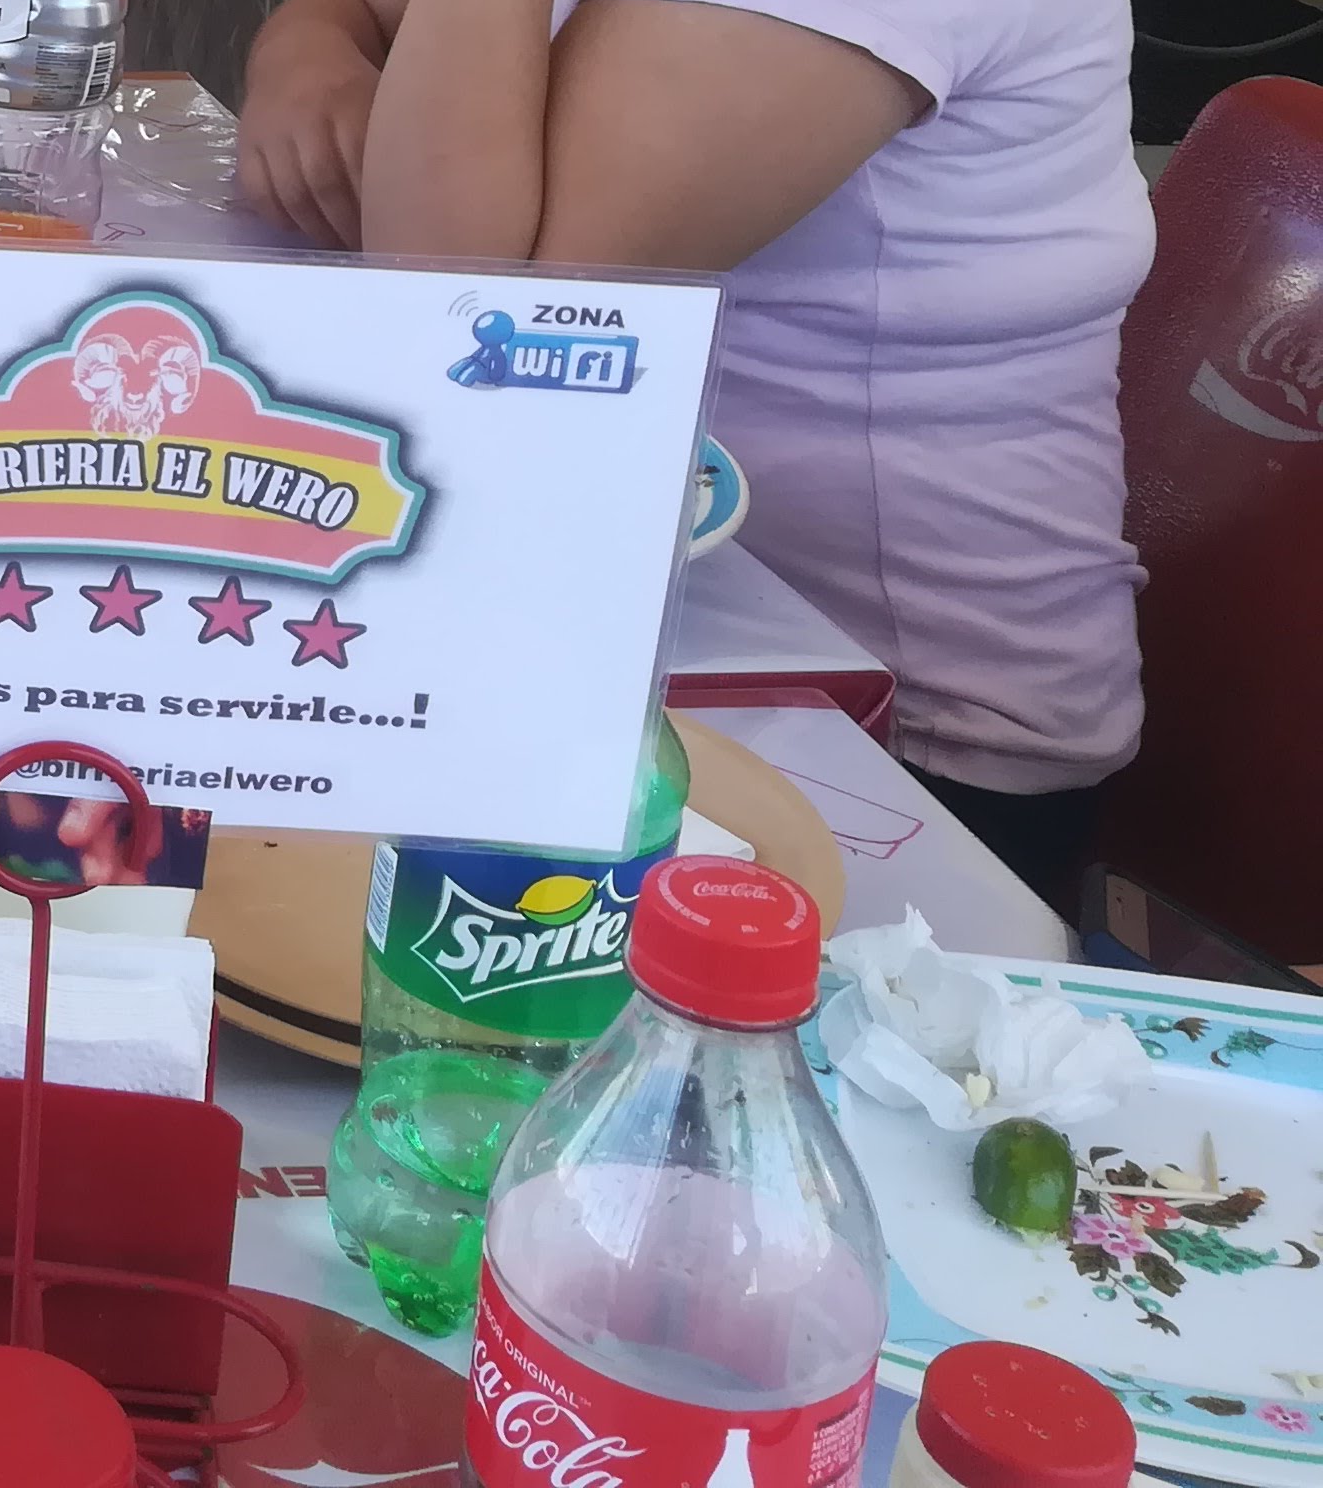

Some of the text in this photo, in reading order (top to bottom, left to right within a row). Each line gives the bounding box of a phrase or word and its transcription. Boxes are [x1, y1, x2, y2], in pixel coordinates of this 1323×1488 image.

[531, 304, 625, 329] ZONA
[155, 443, 211, 496] EL
[224, 453, 357, 531] WERO
[24, 685, 146, 714] para
[435, 898, 628, 985] Sprite
